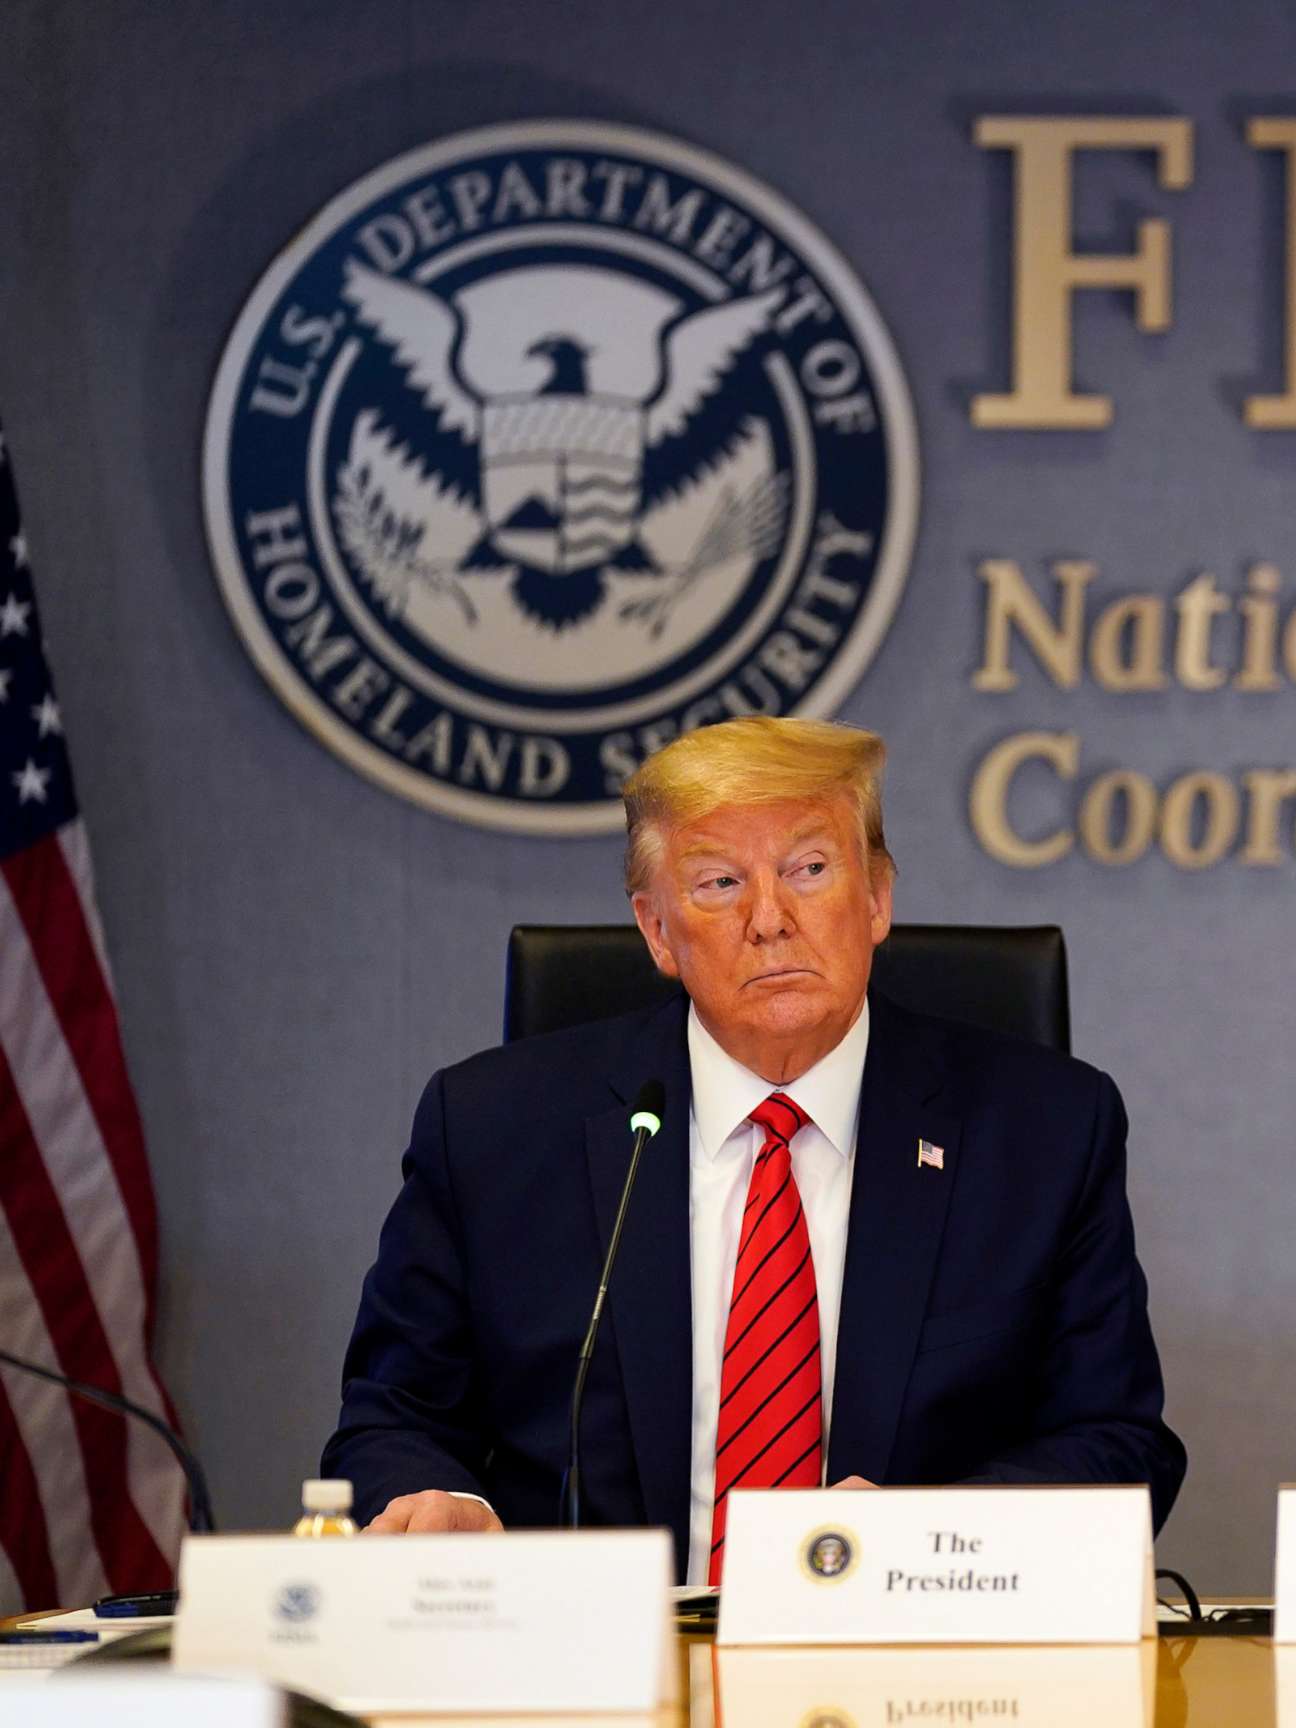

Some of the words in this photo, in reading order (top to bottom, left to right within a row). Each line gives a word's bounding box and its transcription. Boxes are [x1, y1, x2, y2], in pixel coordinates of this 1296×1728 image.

[250, 305, 343, 419] U.S.
[356, 158, 836, 343] DEPARTMENT
[803, 337, 876, 436] OF
[246, 504, 570, 798] HOMELAND
[885, 1568, 1020, 1592] President
[928, 1531, 984, 1554] The
